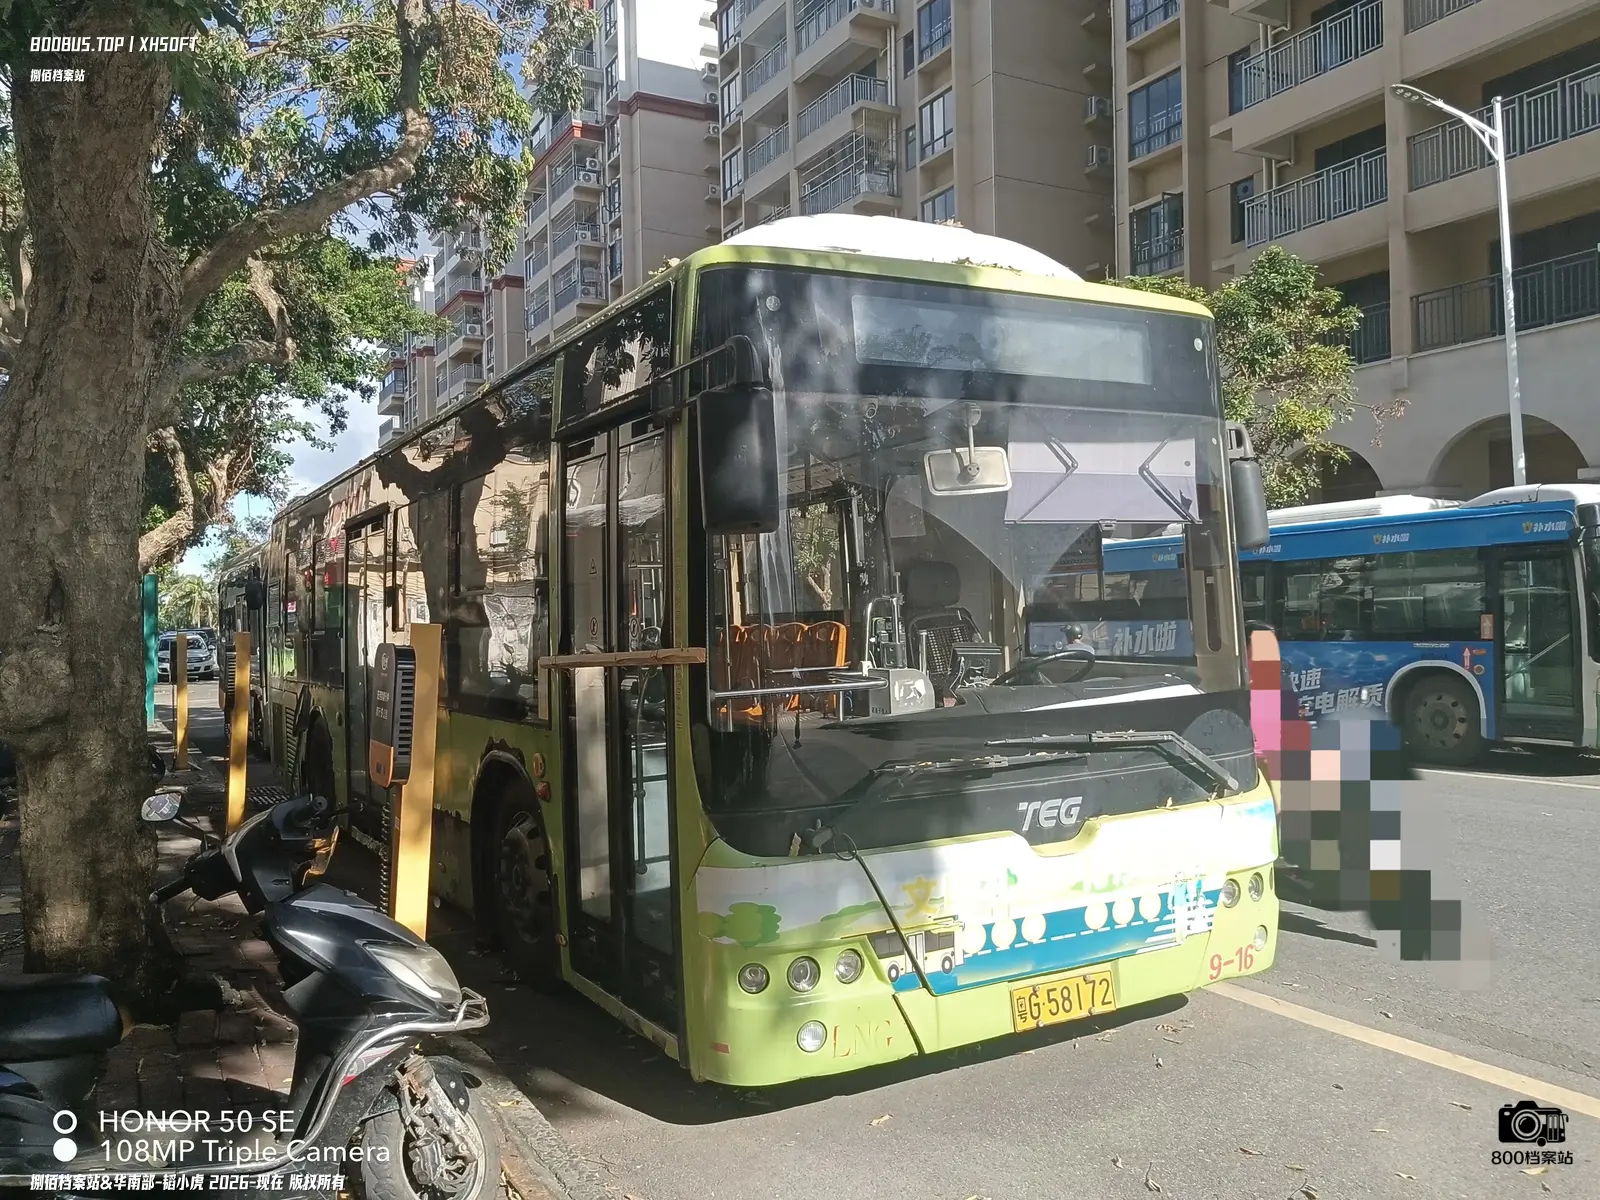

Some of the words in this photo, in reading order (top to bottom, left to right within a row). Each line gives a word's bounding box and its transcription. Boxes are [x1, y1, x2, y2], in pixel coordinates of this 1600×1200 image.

[1113, 620, 1177, 656] 补水啦
[1018, 796, 1083, 832] TEG
[1209, 943, 1254, 981] 9-16
